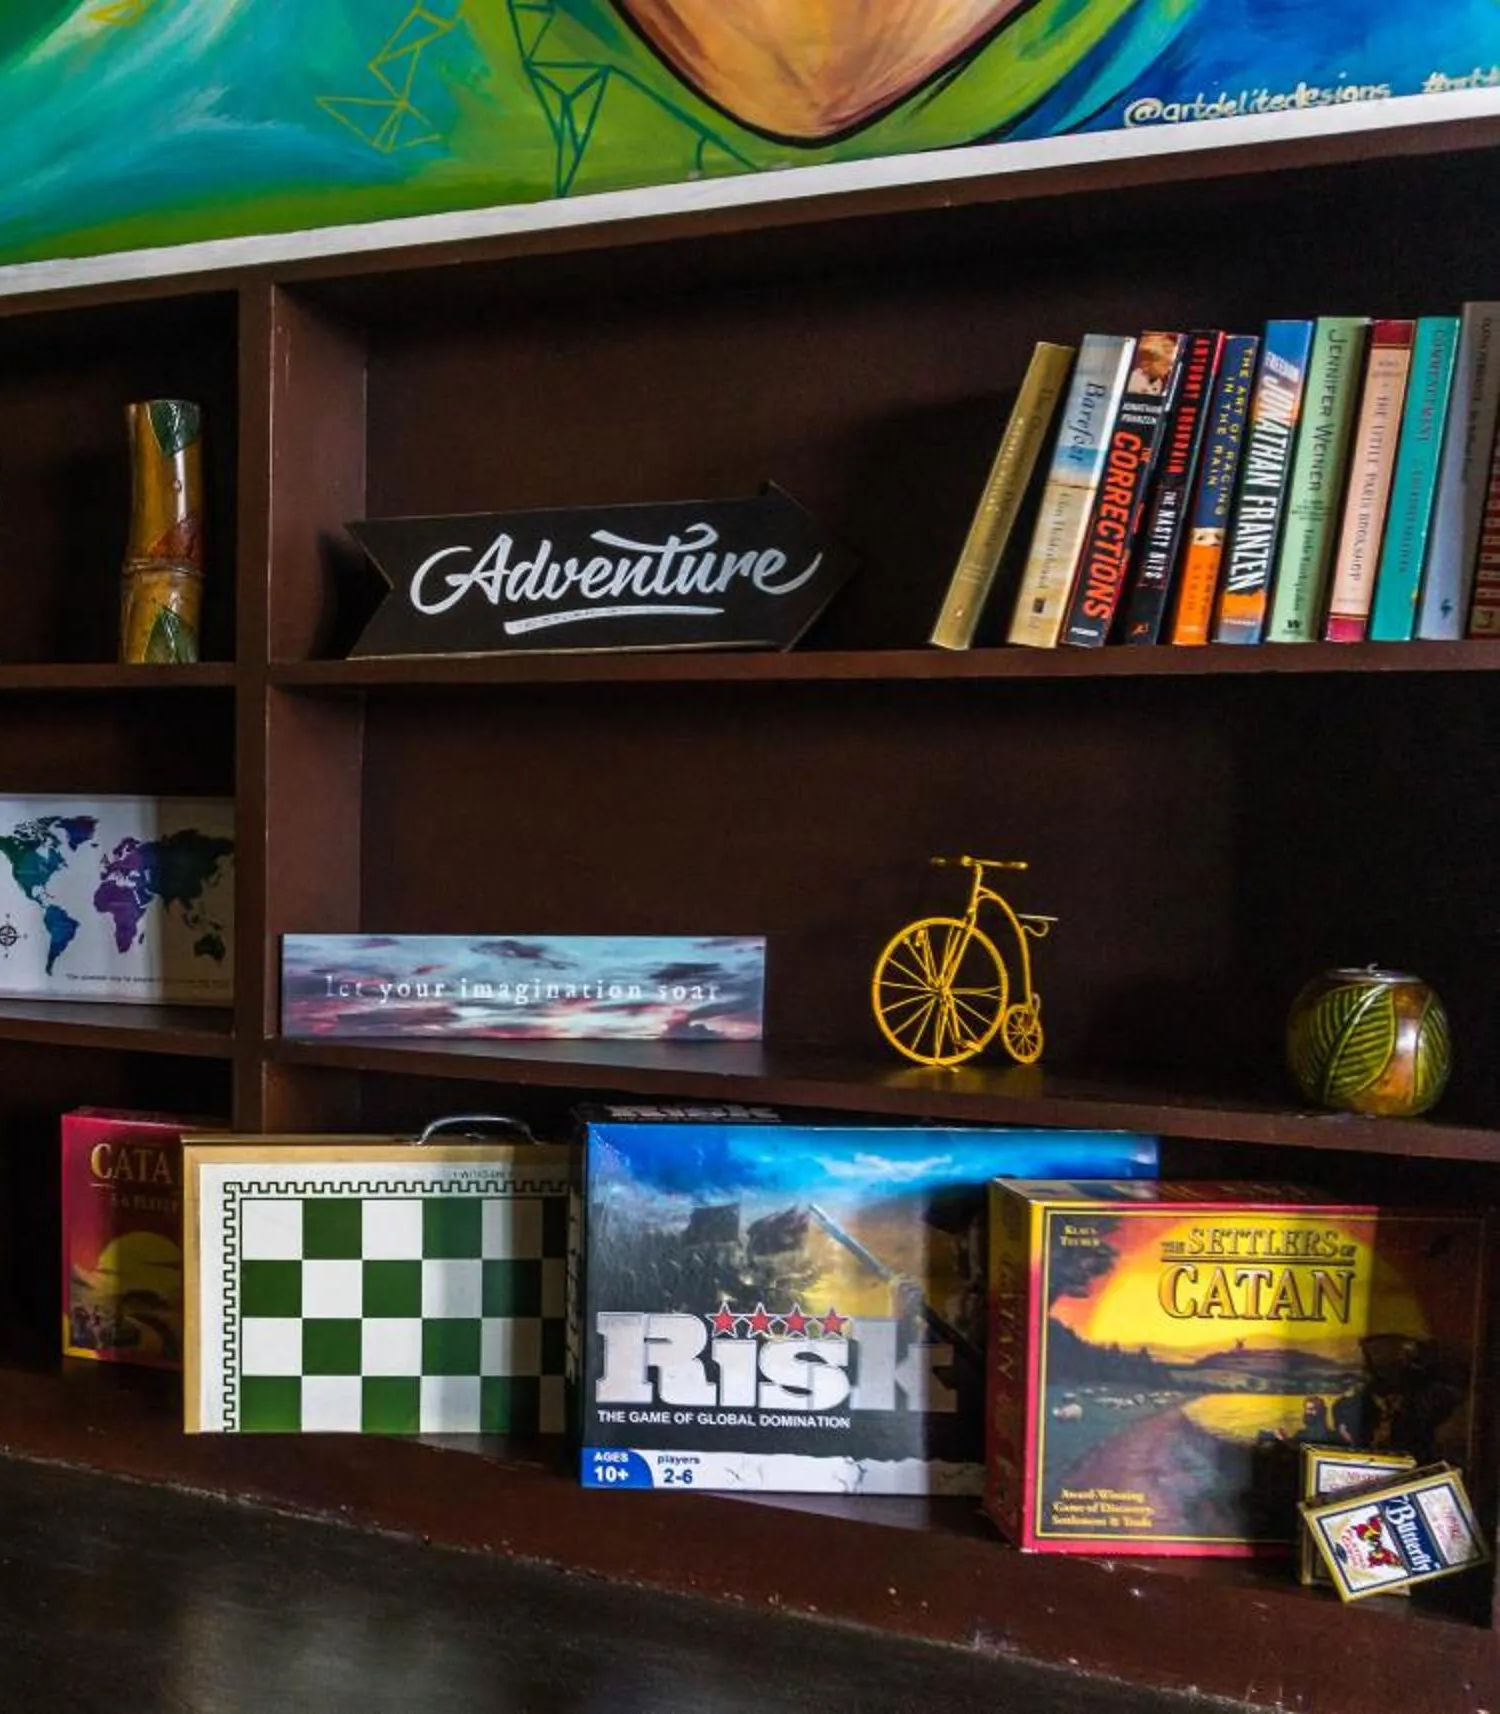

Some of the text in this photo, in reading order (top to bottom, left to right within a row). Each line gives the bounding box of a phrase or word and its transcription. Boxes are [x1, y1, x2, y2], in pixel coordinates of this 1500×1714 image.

[1062, 380, 1107, 463] Barefoot
[1208, 376, 1235, 486] IN THE RAIN
[1214, 347, 1255, 516] THE ART OF RACING
[1246, 375, 1297, 486] JONATHAN
[1307, 329, 1348, 491] JENNIFER WEINER
[1082, 431, 1142, 620] CORRECTIONS
[1151, 509, 1178, 547] NASTY
[1229, 495, 1278, 592] FRANZEN
[410, 522, 823, 614] Adventure
[1144, 551, 1169, 579] BITS
[325, 976, 722, 1005] let your imagination soar
[90, 1143, 180, 1184] CATA
[1187, 1227, 1339, 1259] SETTLERS
[1157, 1262, 1356, 1324] CATAN
[597, 1410, 851, 1429] THE GAME OF GLOBAL DOMINATION
[593, 1451, 629, 1463] AGES
[594, 1466, 629, 1482] 10+
[657, 1454, 701, 1466] players
[663, 1469, 693, 1484] 2-6
[1384, 1498, 1432, 1572] Butterfly
